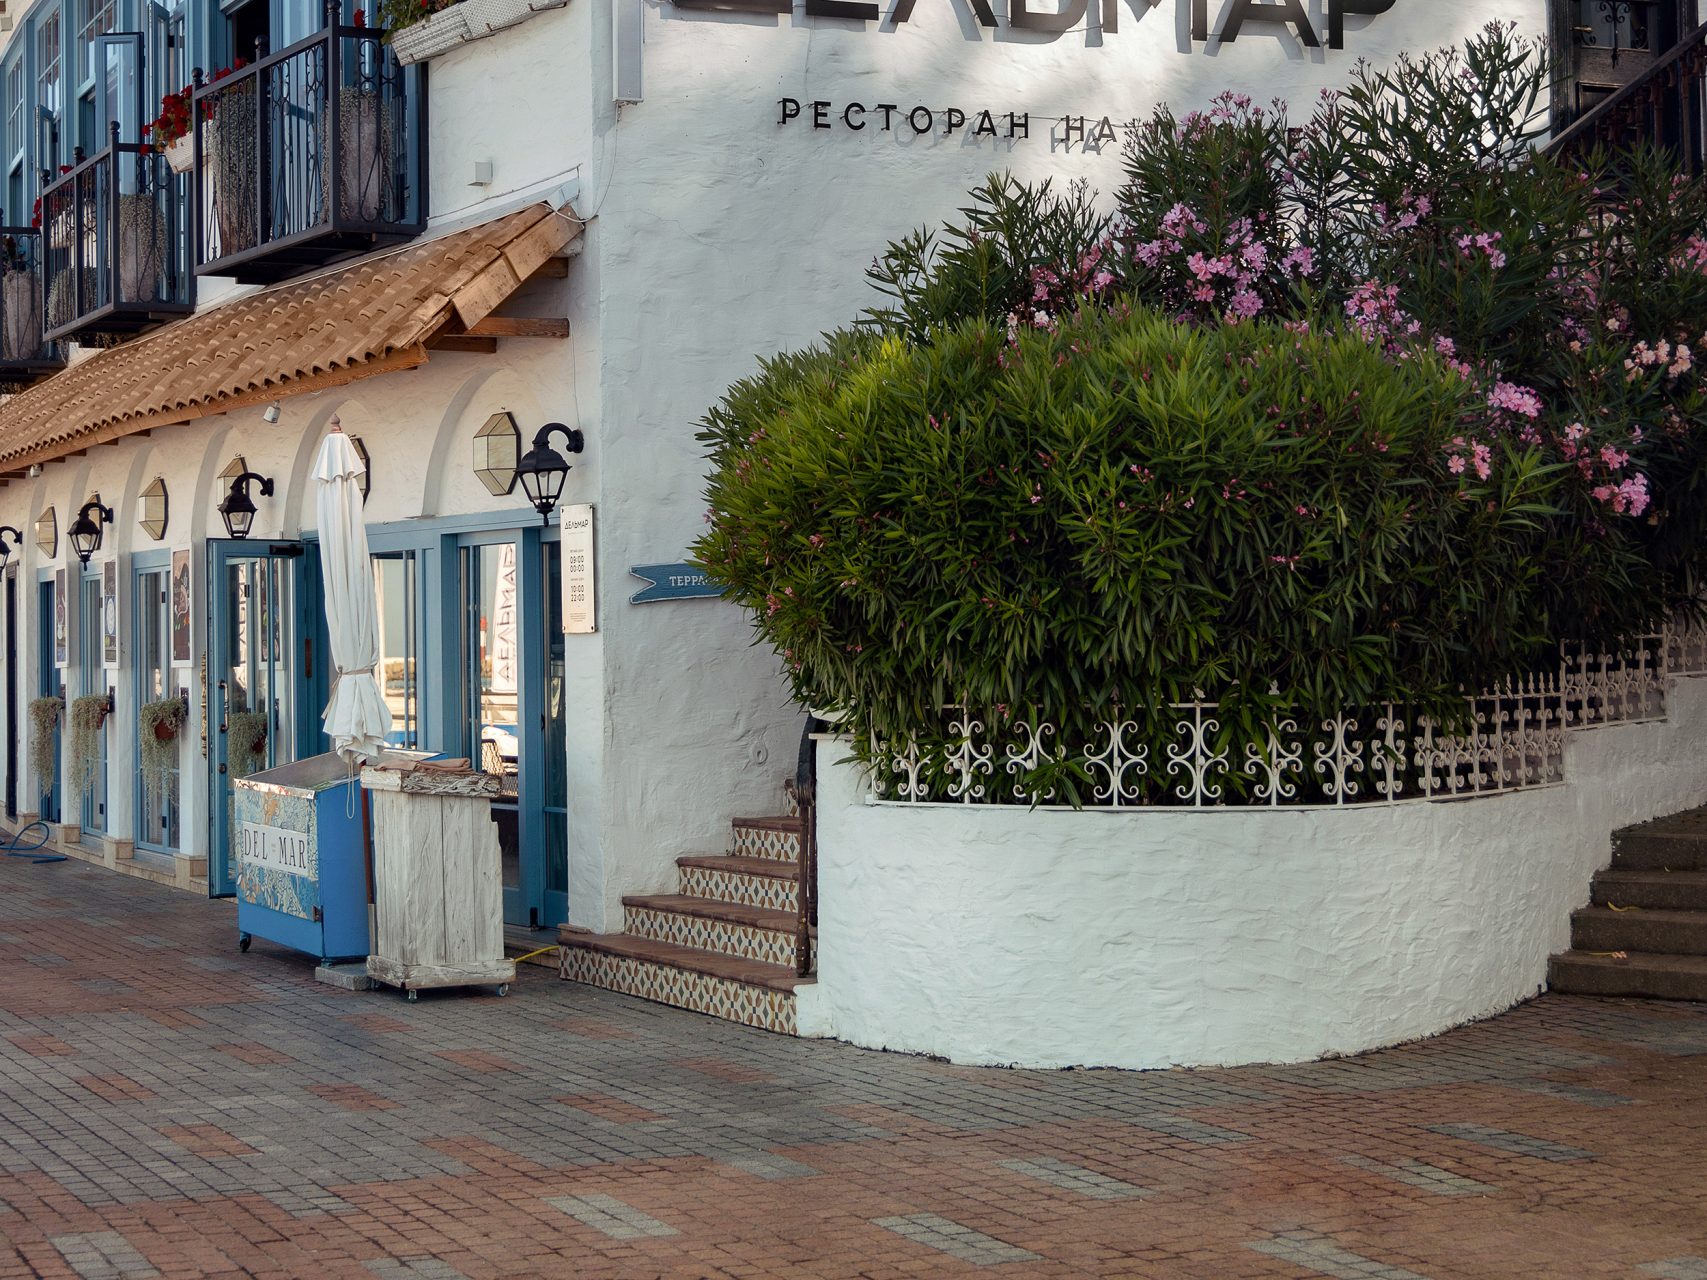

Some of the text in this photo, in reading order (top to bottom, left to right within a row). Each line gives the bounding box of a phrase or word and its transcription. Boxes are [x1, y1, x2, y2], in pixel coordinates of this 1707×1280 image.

[779, 97, 1117, 142] РЕСТОРАН НА
[565, 519, 589, 530] ДЕЛЬМАР
[669, 575, 719, 587] ТЕРРА
[244, 828, 306, 869] DEL MAR
